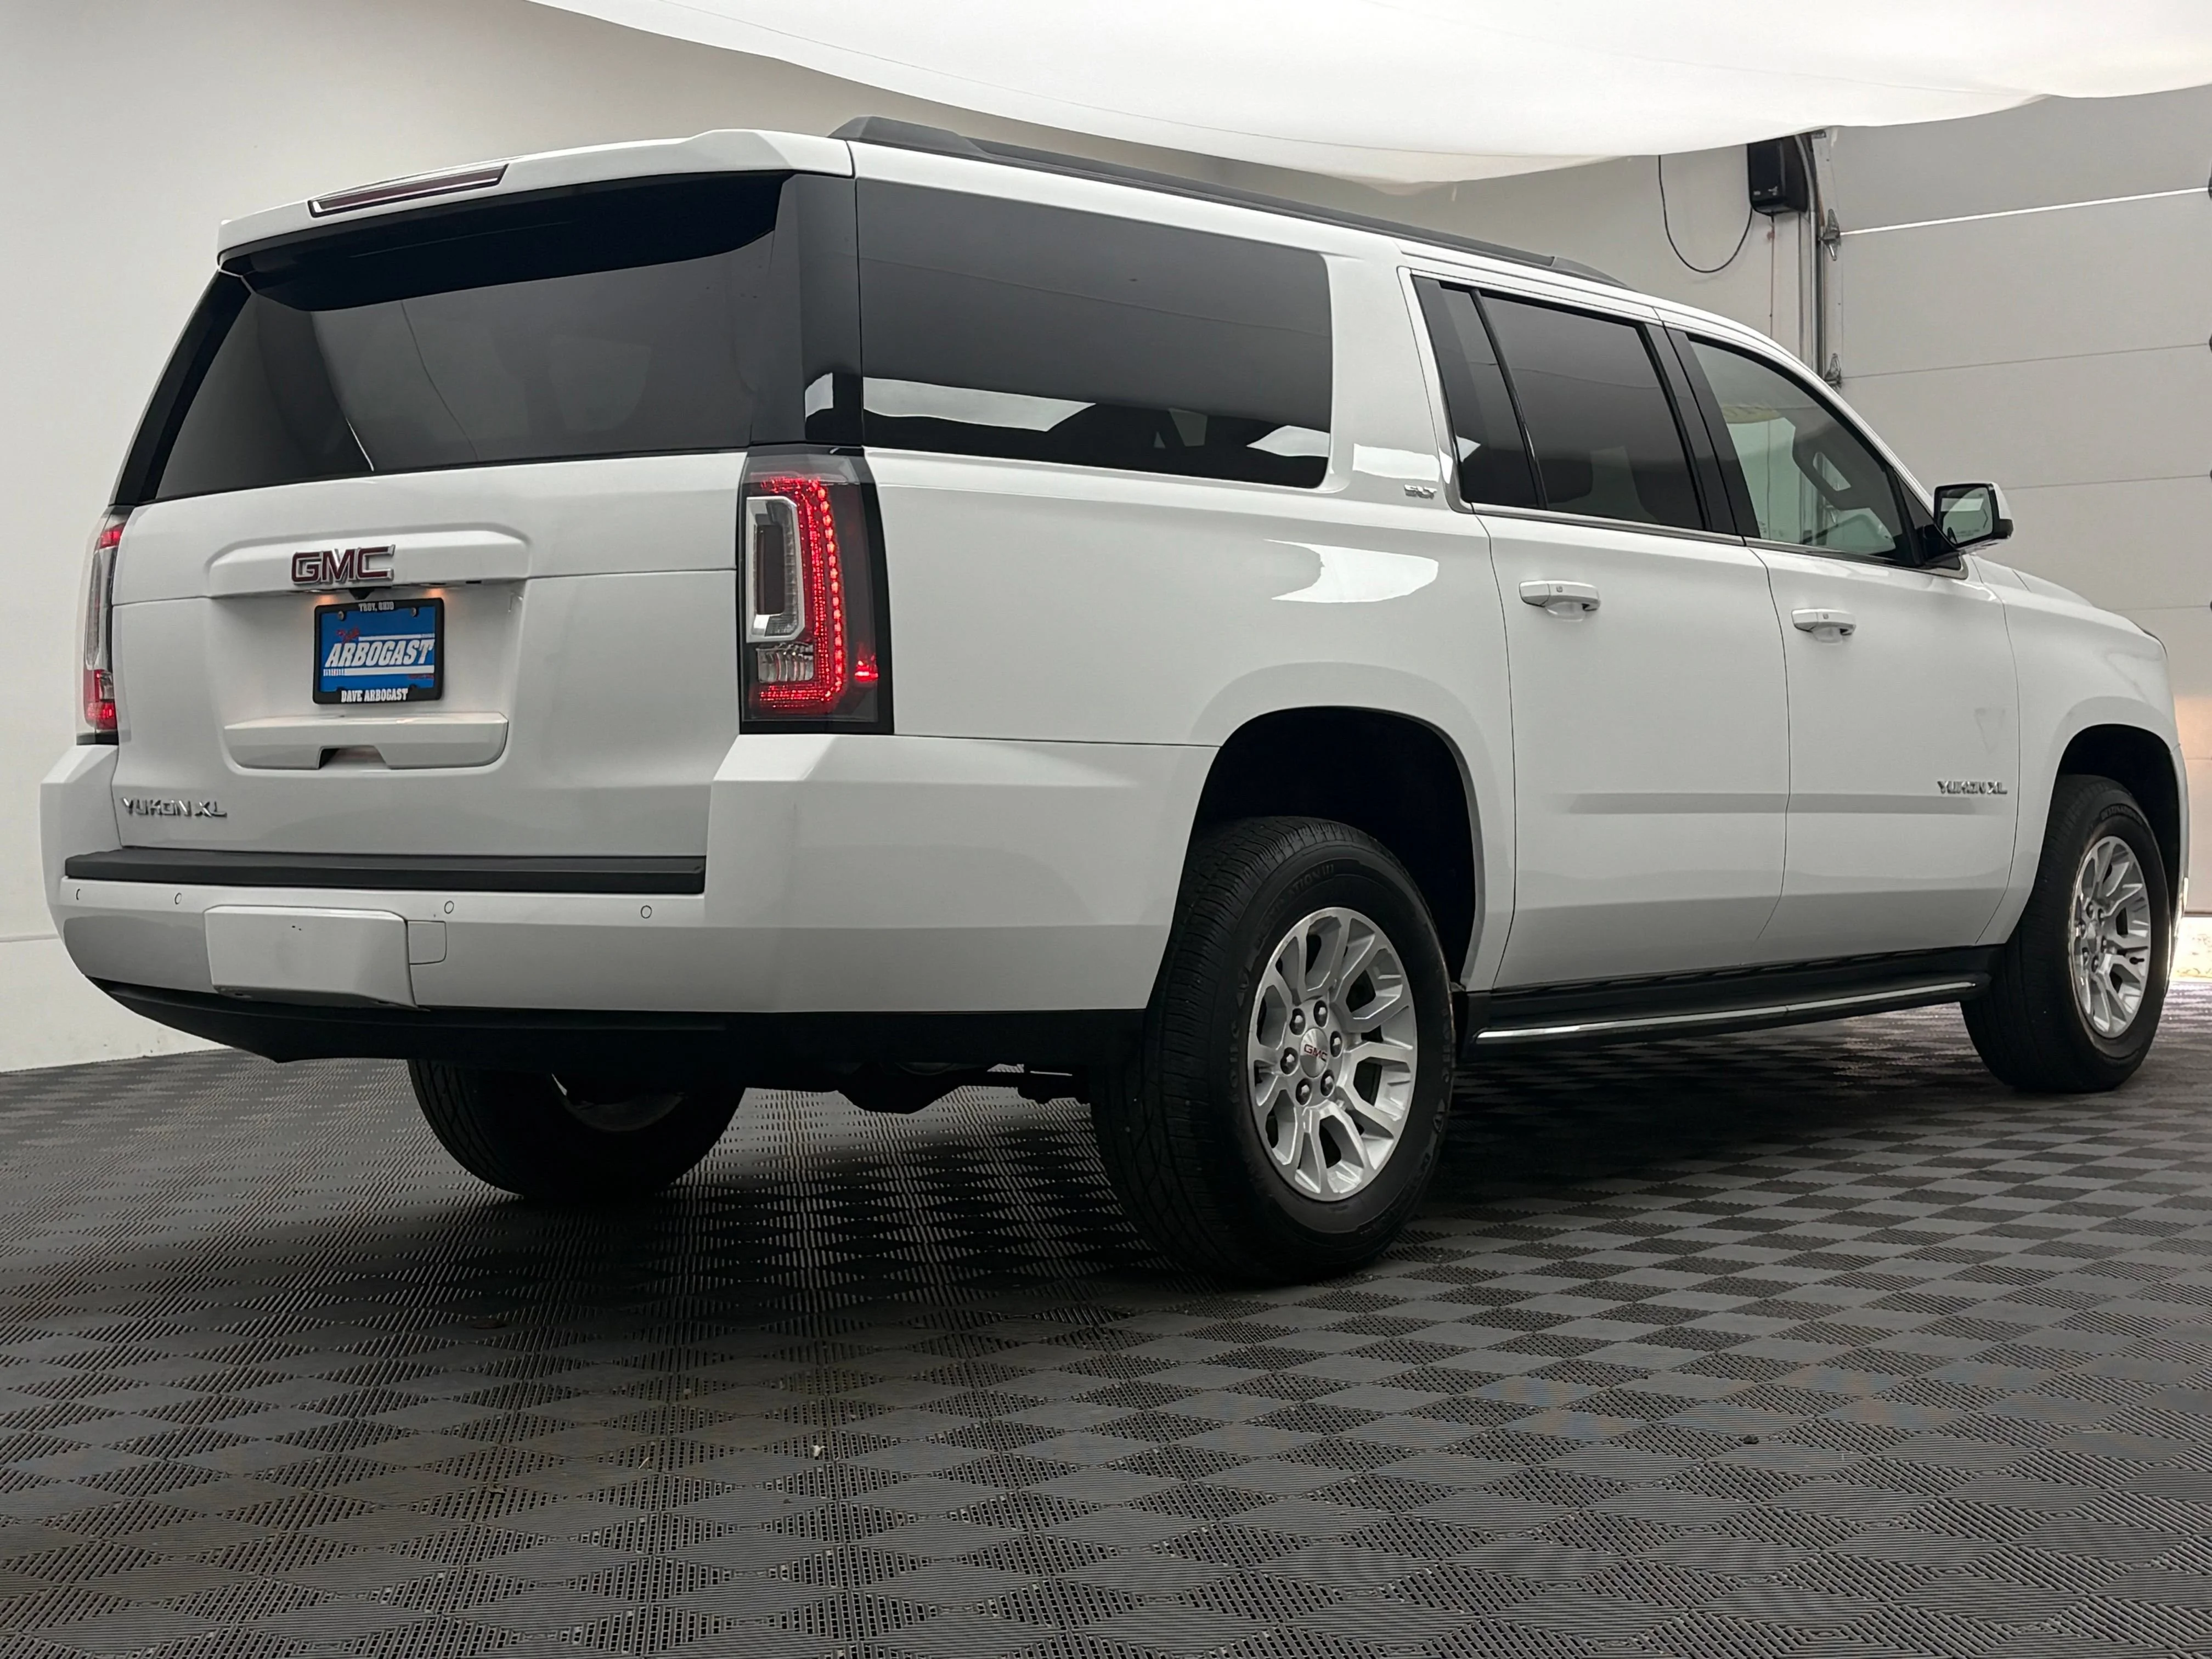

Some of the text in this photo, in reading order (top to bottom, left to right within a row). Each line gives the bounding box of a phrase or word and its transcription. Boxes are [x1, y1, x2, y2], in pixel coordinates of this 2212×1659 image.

[291, 544, 396, 586] GMC
[325, 639, 435, 667] ARBOGAST
[341, 688, 408, 702] DAVE ARBOGAST
[1937, 780, 2008, 795] YUKON XL
[122, 797, 228, 817] YUKON XL
[1304, 1043, 1328, 1063] GMC
